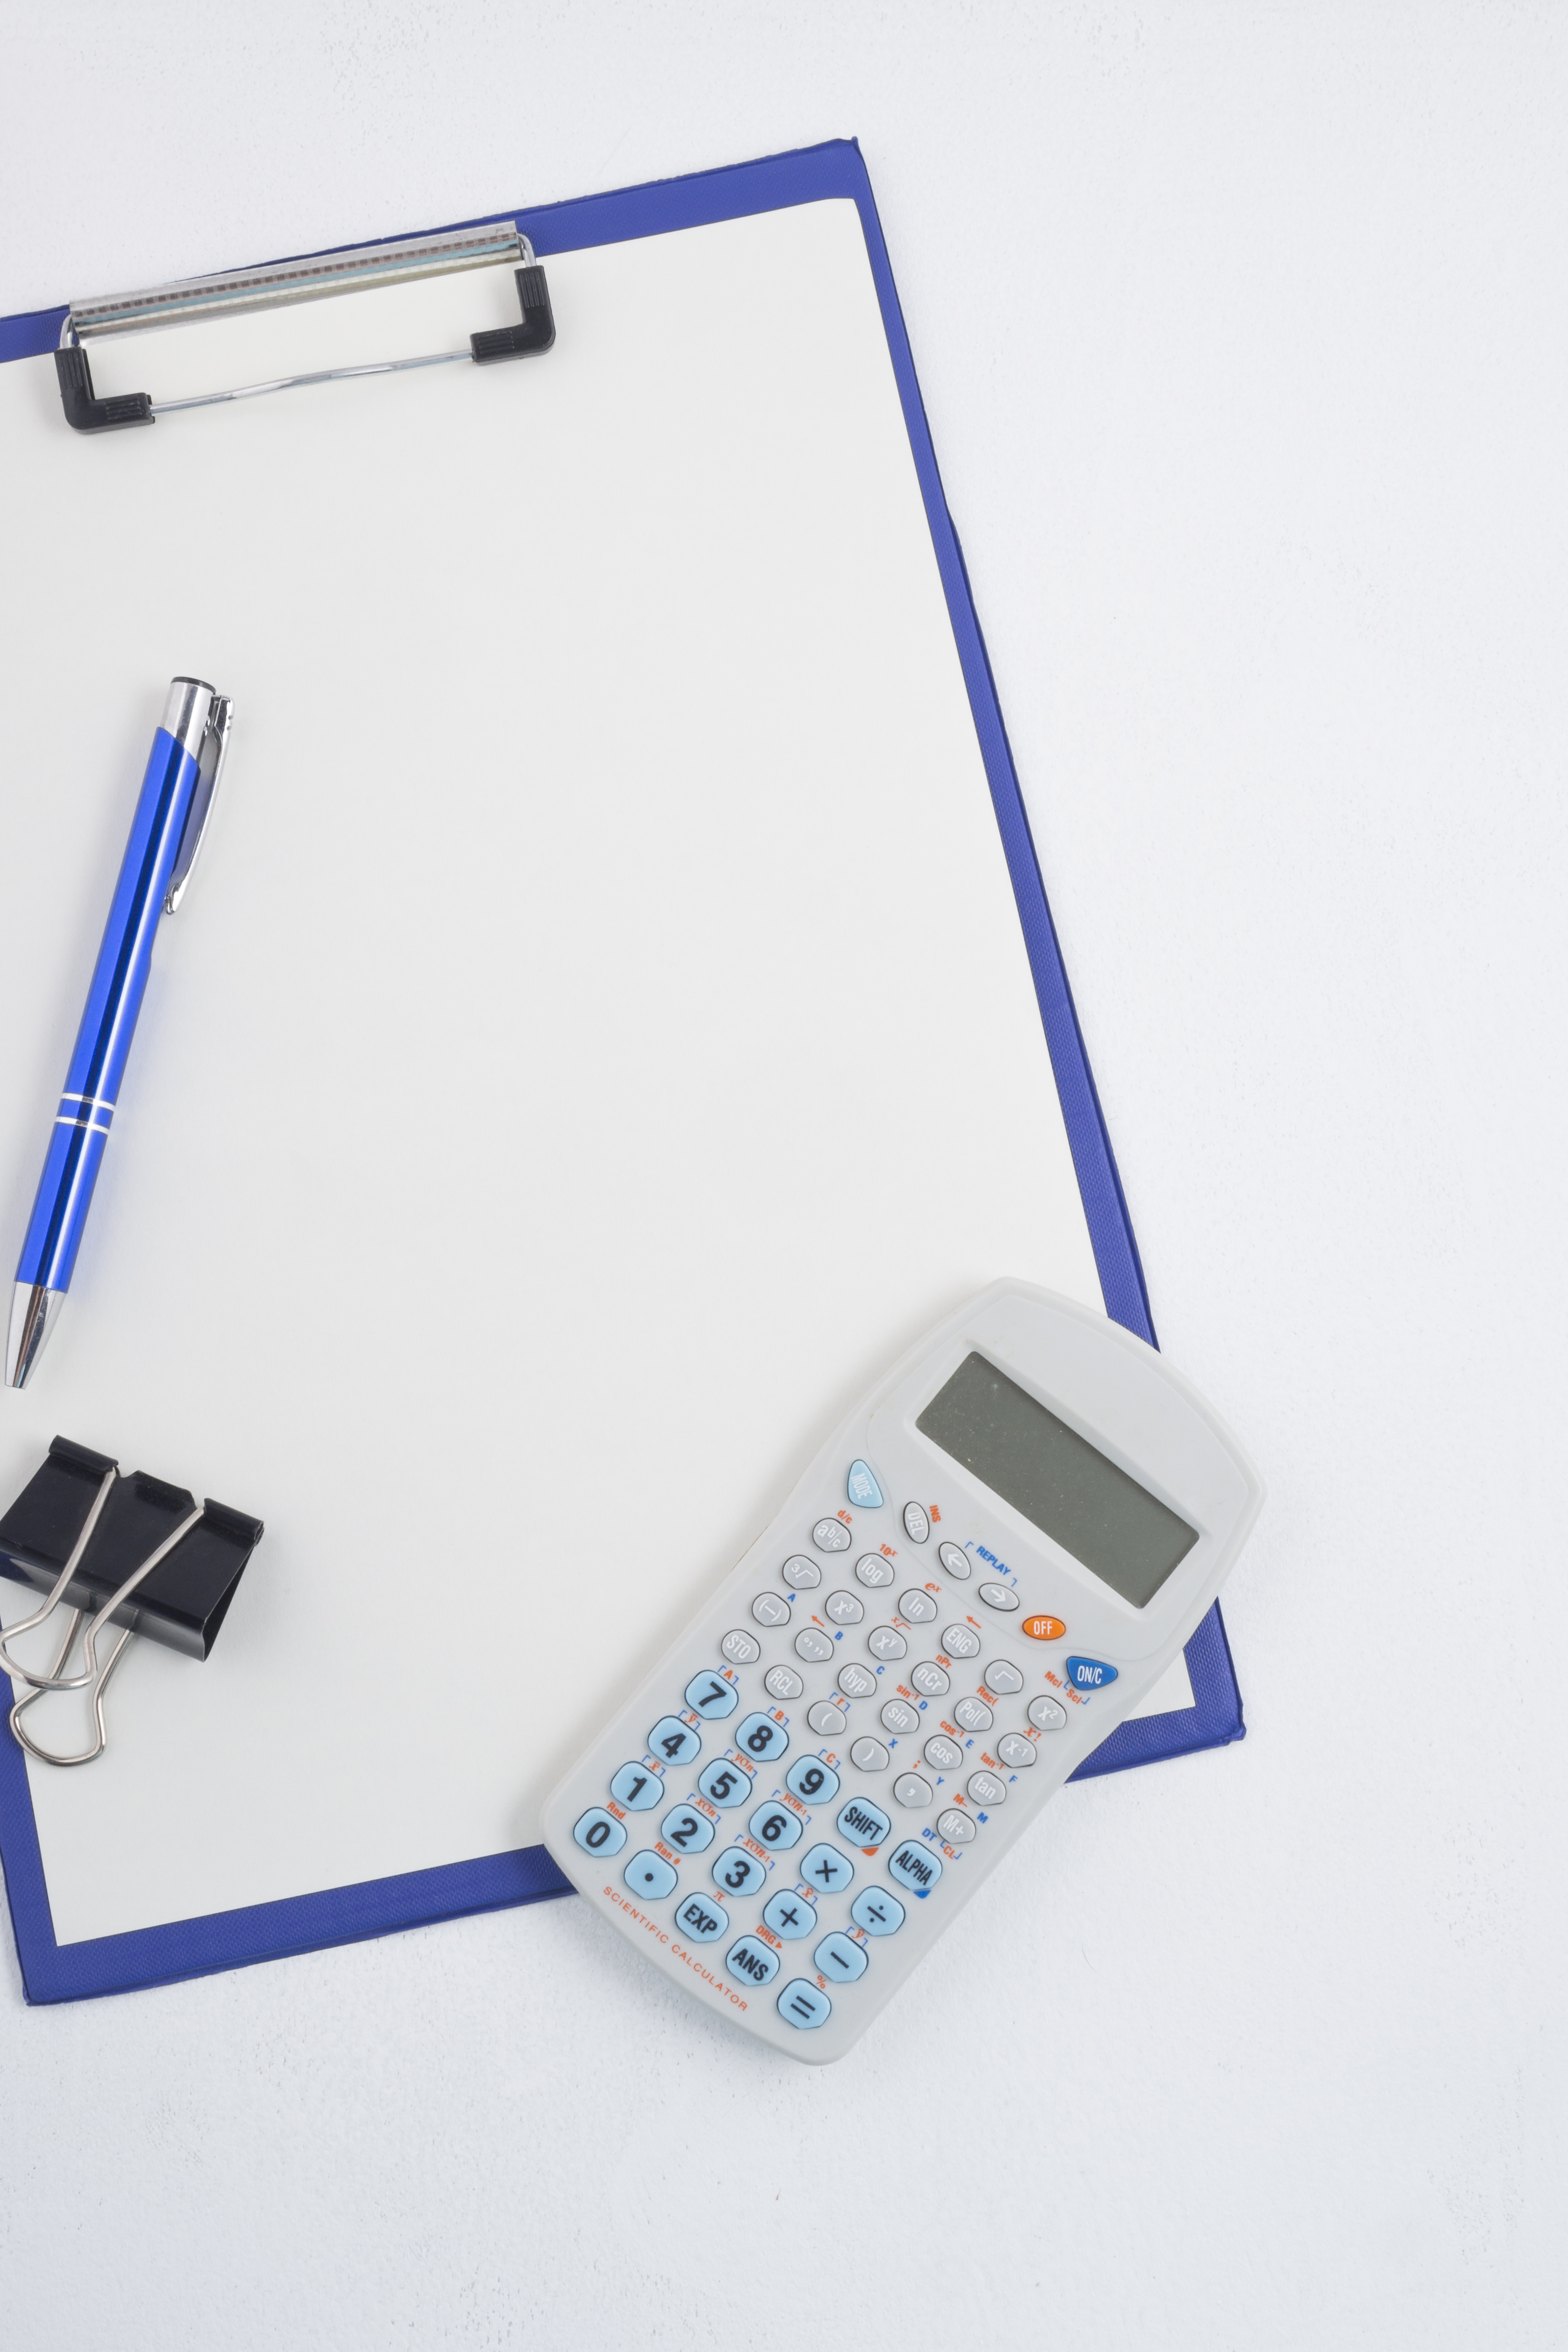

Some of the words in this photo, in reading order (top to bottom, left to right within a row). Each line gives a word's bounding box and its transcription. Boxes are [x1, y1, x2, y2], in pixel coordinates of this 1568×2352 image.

[851, 1473, 873, 1500] MODE
[837, 1510, 852, 1524] d/c
[907, 1512, 924, 1535] DEL
[929, 1505, 941, 1523] INS
[861, 1558, 884, 1584] log
[976, 1546, 1011, 1575] REPLAY
[787, 1594, 796, 1602] A
[835, 1631, 844, 1640] B
[1034, 1621, 1052, 1635] OFF
[726, 1634, 751, 1659] STO
[946, 1628, 972, 1654] ENG
[876, 1666, 885, 1675] C
[936, 1654, 952, 1669] nPr
[723, 1670, 733, 1680] A
[769, 1670, 793, 1696] RCL
[844, 1667, 867, 1693] hyp
[917, 1668, 942, 1691] nCr
[1077, 1665, 1102, 1684] ON/C
[698, 1681, 727, 1707] 7
[774, 1710, 785, 1721] B
[919, 1701, 928, 1710] D
[888, 1707, 909, 1728] sin
[661, 1733, 687, 1758] 4
[748, 1725, 773, 1752] 8
[888, 1738, 898, 1748] X
[965, 1739, 975, 1749] E
[826, 1753, 837, 1763] C
[930, 1742, 953, 1764] cos
[627, 1777, 648, 1802] 1
[710, 1771, 738, 1800] 5
[799, 1768, 825, 1796] 9
[936, 1777, 945, 1785] Y
[974, 1776, 996, 1800] tan
[1009, 1775, 1018, 1783] F
[606, 1802, 627, 1820] Rnd
[977, 1812, 989, 1824] M
[670, 1817, 698, 1848] 2
[762, 1815, 787, 1842] 6
[844, 1806, 883, 1841] SHIFT
[943, 1815, 964, 1836] M+
[586, 1822, 610, 1848] 0
[922, 1828, 938, 1842] DT
[654, 1842, 673, 1860] Ran
[943, 1846, 955, 1859] CL
[725, 1860, 751, 1888] 3
[895, 1850, 933, 1885] ALPHA
[683, 1903, 718, 1934] EXP
[755, 1925, 777, 1945] DRG
[603, 1886, 669, 1944] SCIENTIFIC
[671, 1944, 748, 2012] CALCULATOR
[731, 1948, 769, 1981] ANS
